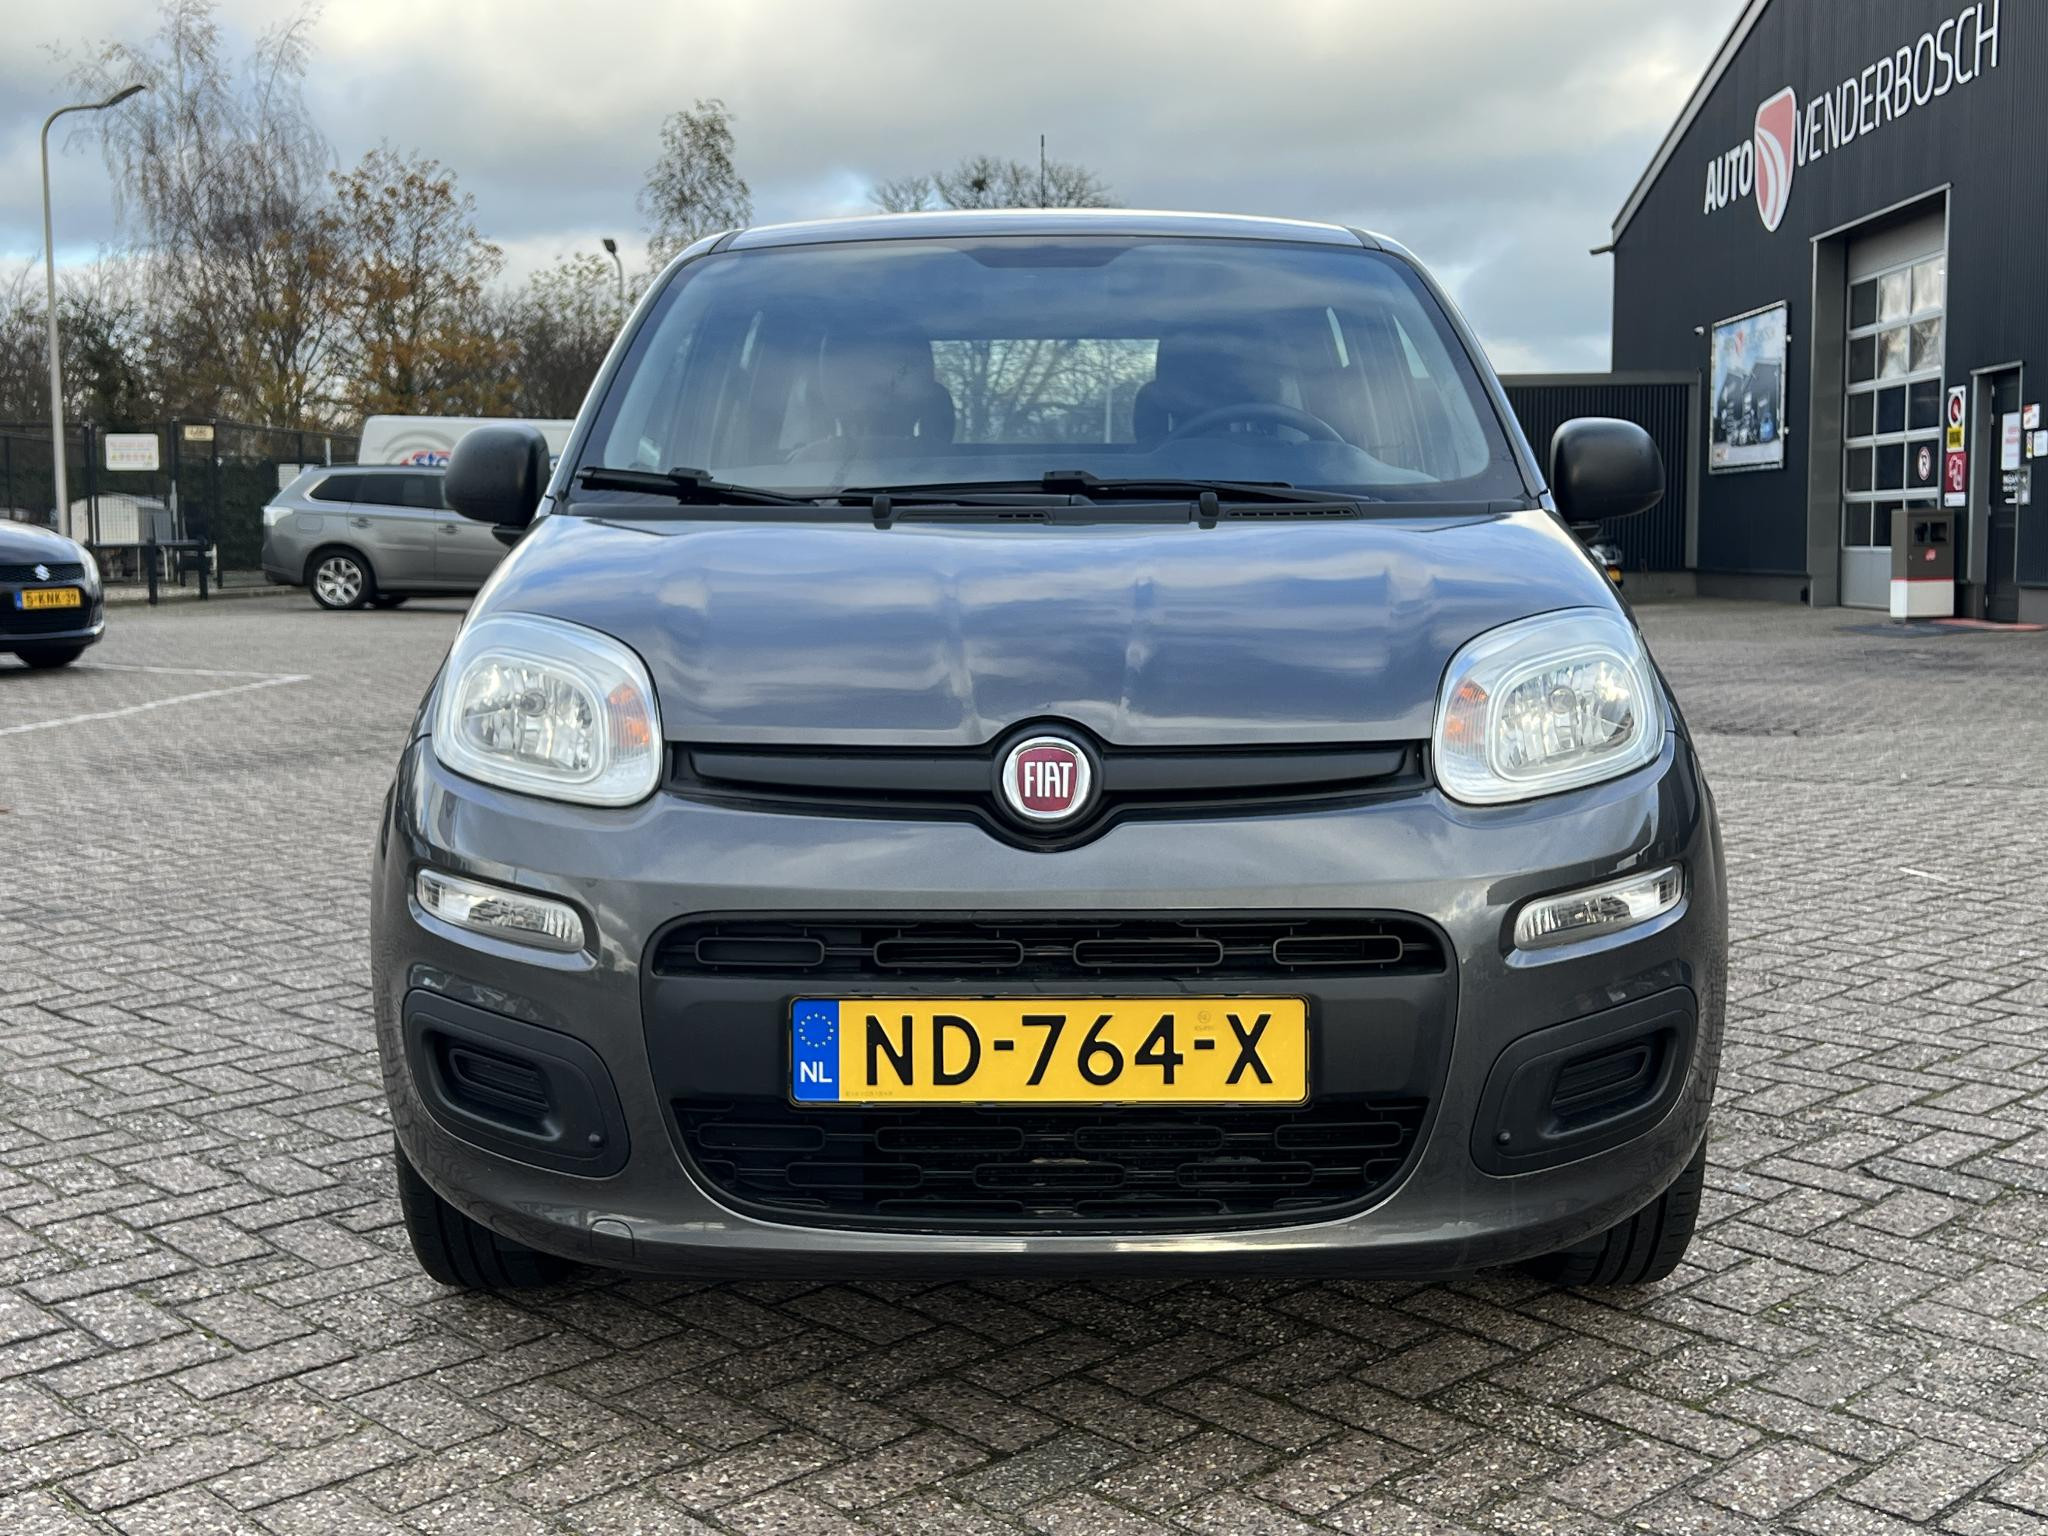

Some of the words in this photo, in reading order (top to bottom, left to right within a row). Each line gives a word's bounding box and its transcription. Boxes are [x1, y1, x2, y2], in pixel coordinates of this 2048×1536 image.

[1704, 139, 1753, 215] AUTO
[1796, 0, 1999, 167] VENDERBOSCH
[1024, 761, 1074, 798] FIAT
[800, 1061, 832, 1083] NL
[865, 1013, 1273, 1086] ND-764-X
